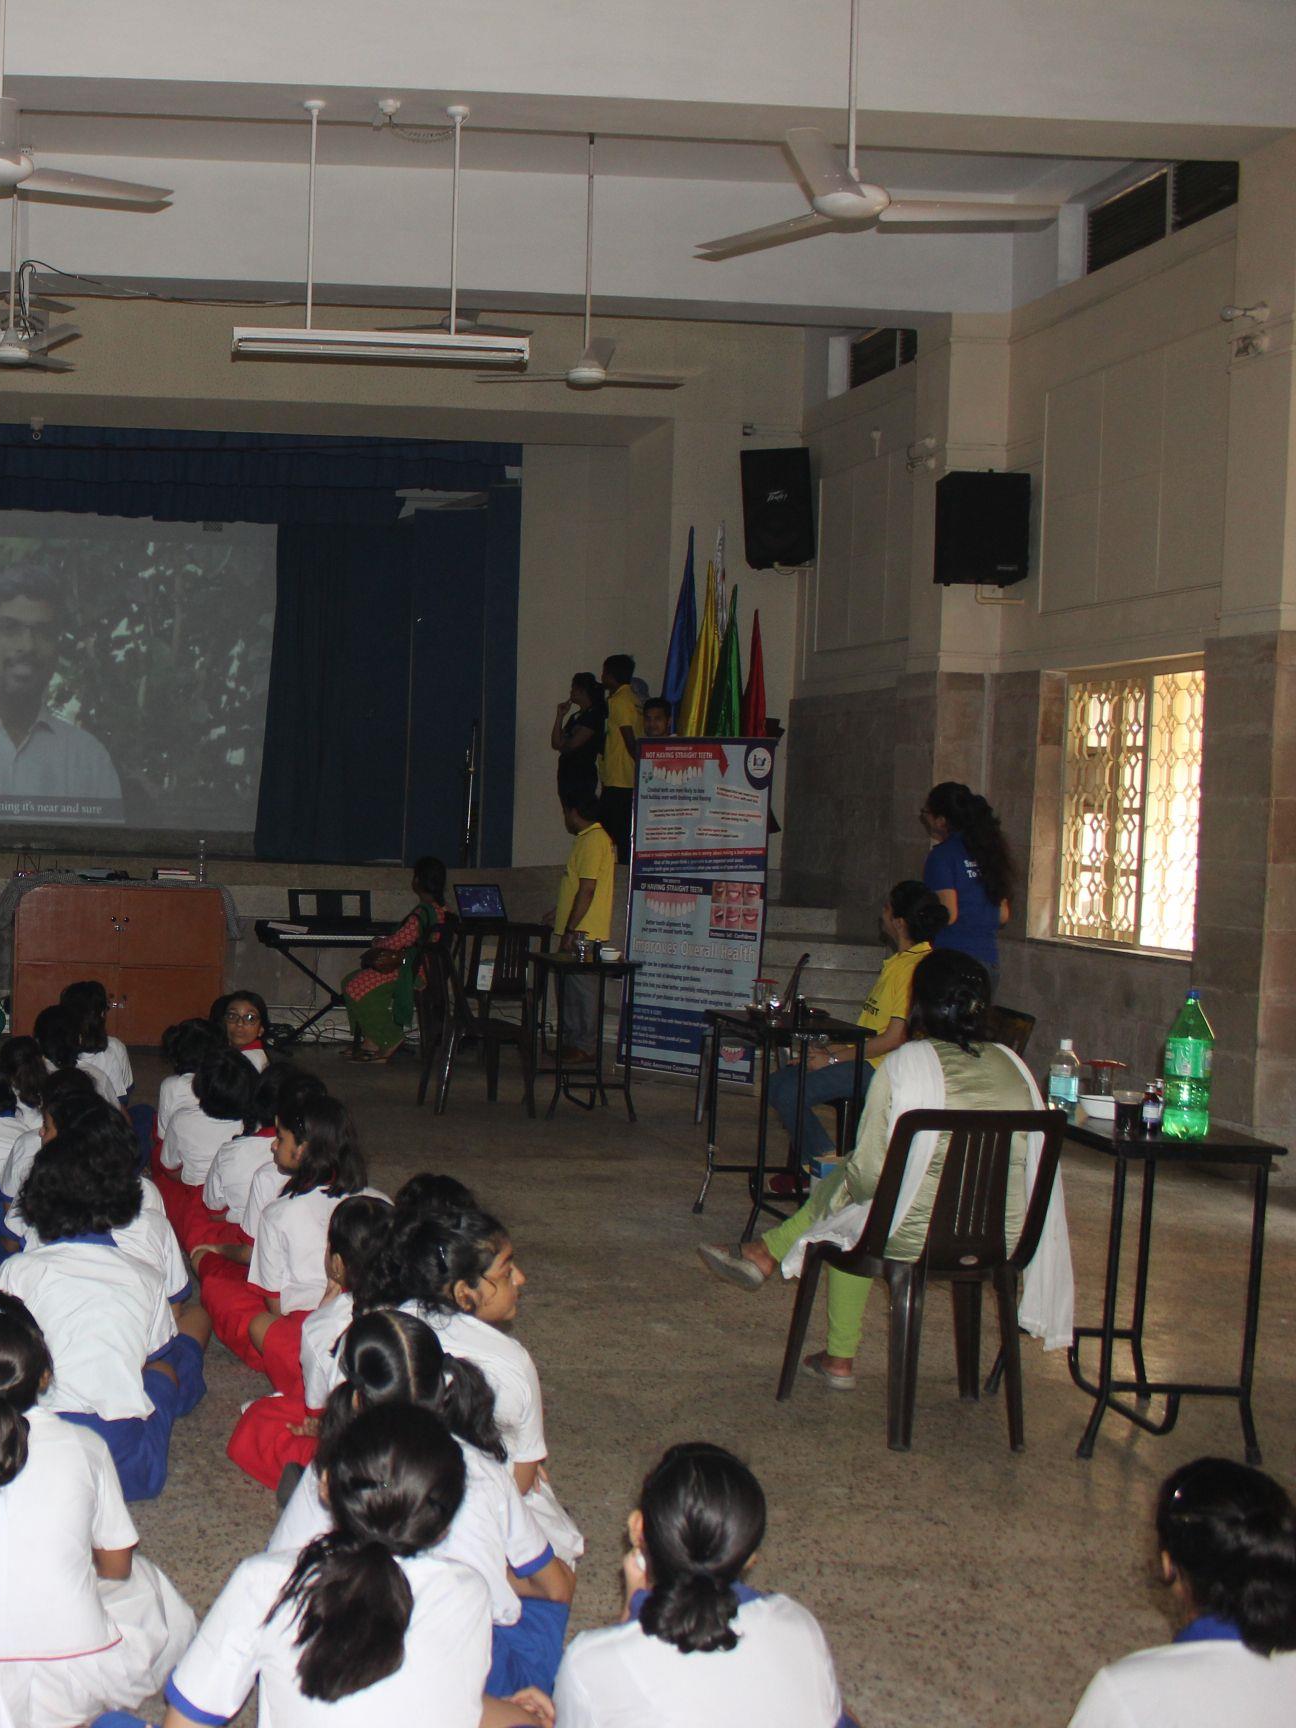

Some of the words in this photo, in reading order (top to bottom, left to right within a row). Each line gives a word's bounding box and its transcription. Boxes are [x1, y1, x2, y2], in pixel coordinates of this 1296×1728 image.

[656, 751, 674, 759] HAVING
[675, 751, 697, 759] STRAIGHT
[37, 803, 57, 812] near
[61, 802, 79, 813] and
[81, 805, 103, 814] sure
[647, 883, 666, 891] HAVING
[666, 884, 689, 892] STRAIGHT
[689, 886, 704, 894] TEETH
[632, 937, 677, 956] Improves
[681, 941, 718, 958] Overall
[721, 944, 756, 962] Health
